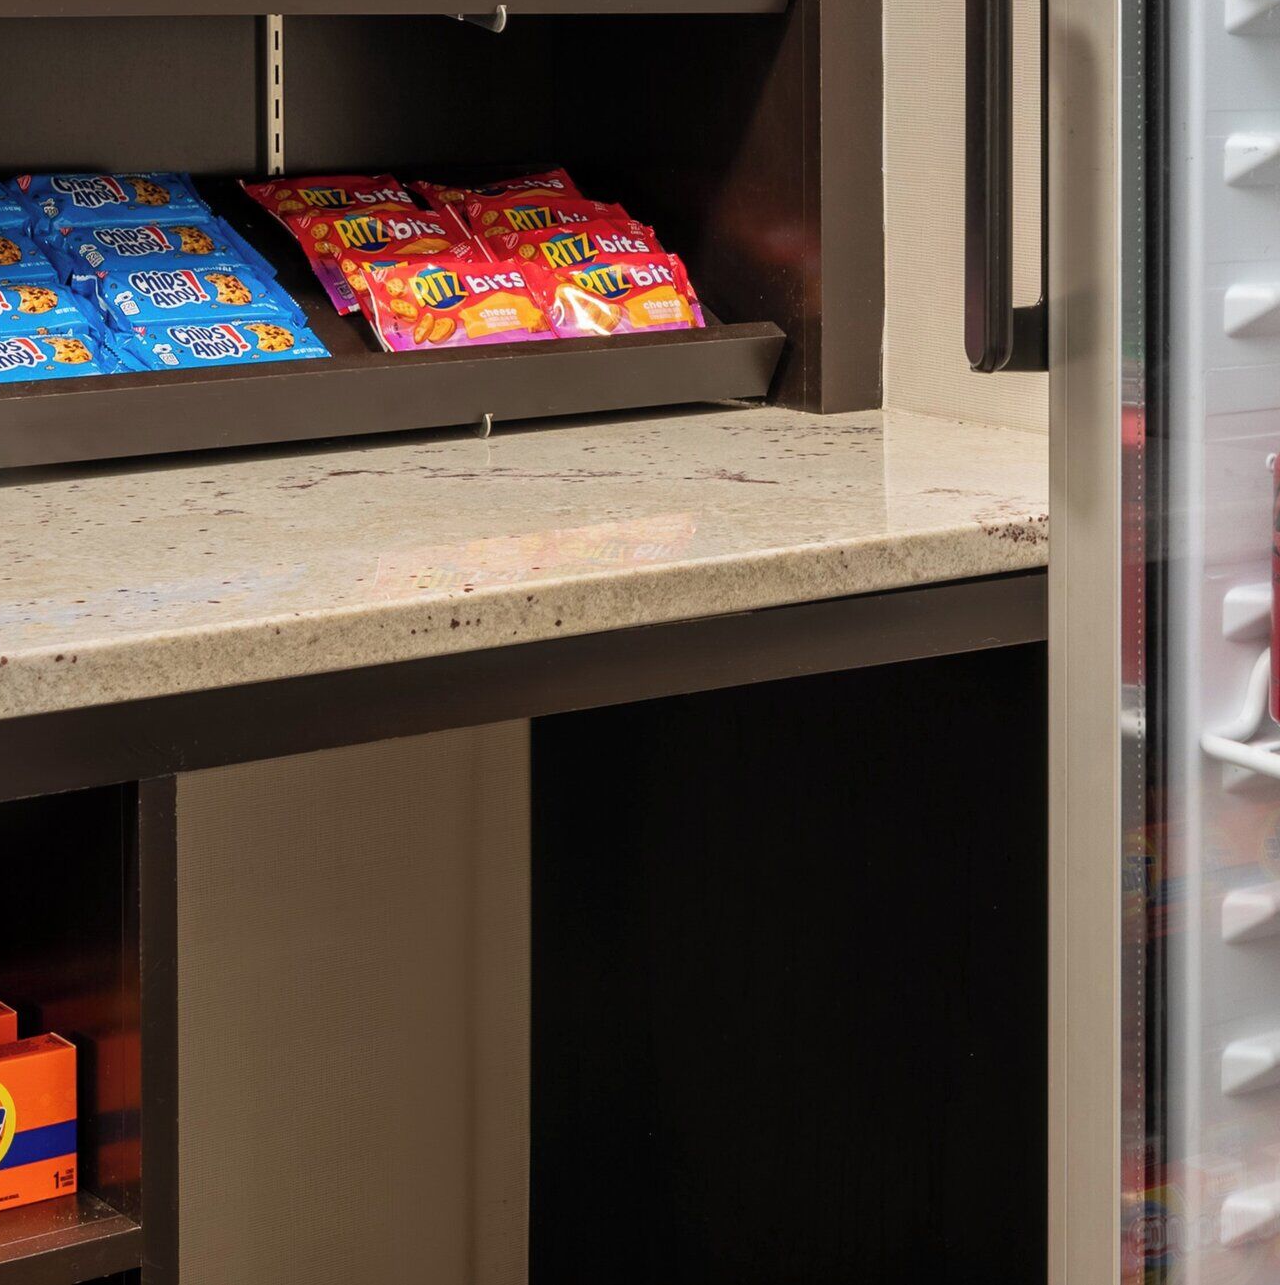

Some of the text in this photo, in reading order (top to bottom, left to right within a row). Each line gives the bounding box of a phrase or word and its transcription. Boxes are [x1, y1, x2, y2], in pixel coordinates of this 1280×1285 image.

[52, 175, 105, 195] Chips
[72, 182, 127, 208] Ahoy!
[297, 188, 413, 207] RITZ bits
[503, 206, 560, 231] RITZ
[96, 226, 149, 246] Chips
[333, 216, 447, 249] RITZ bits
[116, 234, 172, 257] Ahoy!
[539, 232, 651, 269] RITZ bits
[130, 270, 186, 294] Chips
[408, 269, 526, 308] RITZ bits
[572, 264, 675, 297] RITZ bit
[121, 301, 137, 312] 220
[152, 280, 209, 309] Ahoy!
[642, 298, 682, 311] cheese
[479, 306, 518, 319] cheese
[169, 325, 224, 346] Chips
[192, 331, 251, 359] Ahoy!
